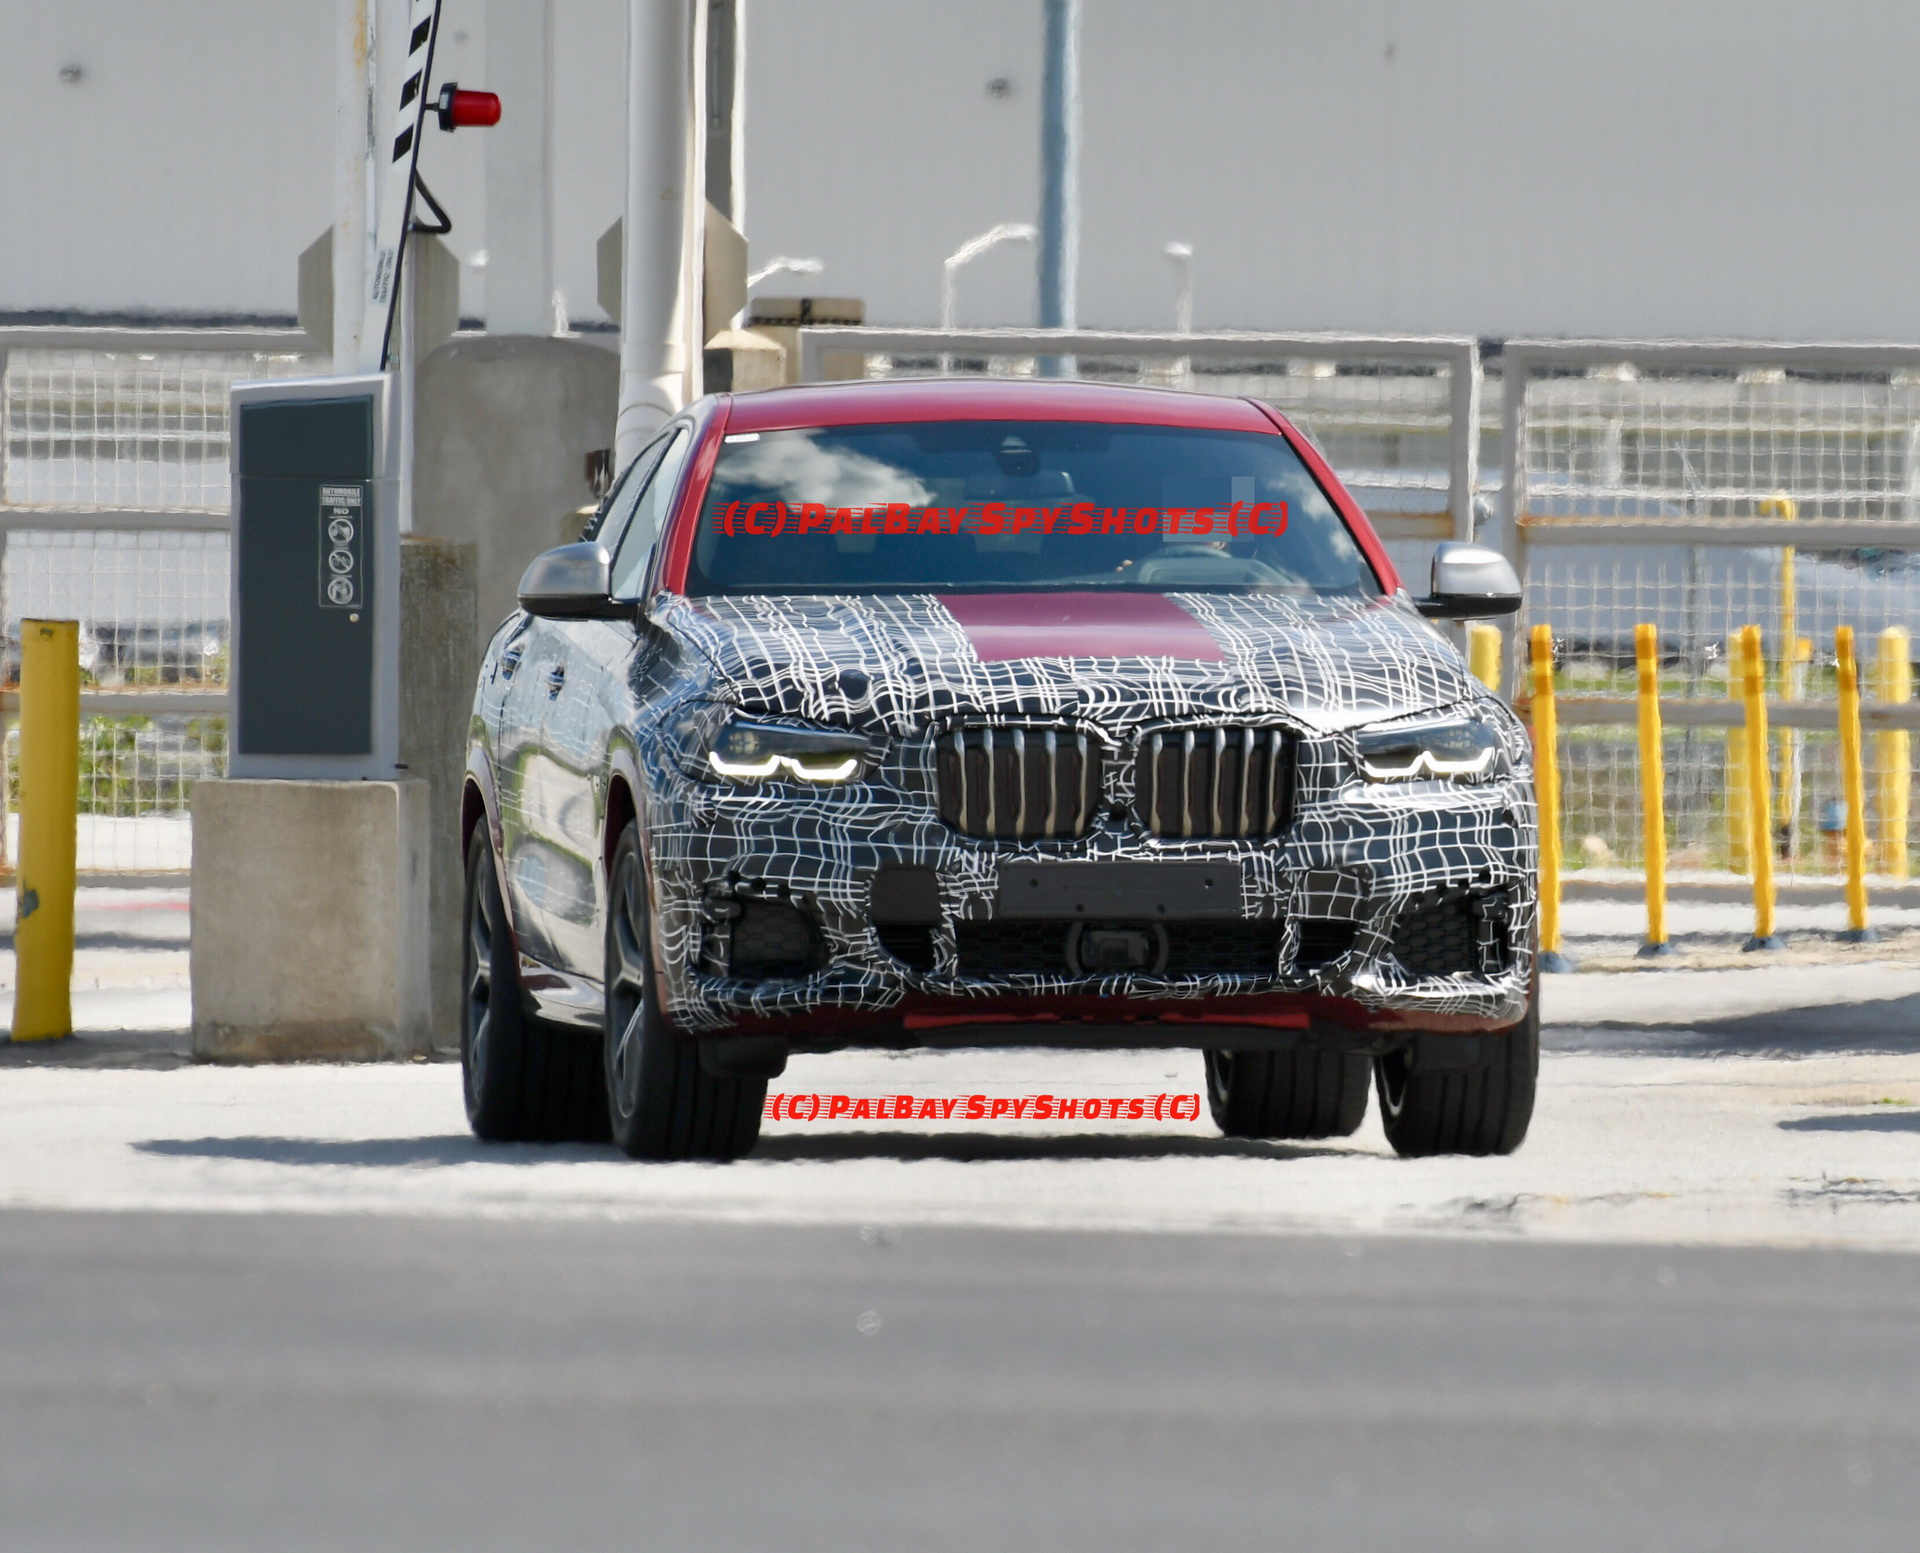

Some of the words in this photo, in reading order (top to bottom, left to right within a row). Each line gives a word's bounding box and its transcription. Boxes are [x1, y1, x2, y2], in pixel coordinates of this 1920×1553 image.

[322, 487, 361, 496] AUTOMOBILE
[321, 496, 346, 505] TRAFFIC
[347, 496, 361, 505] ONLY
[333, 507, 350, 515] NO
